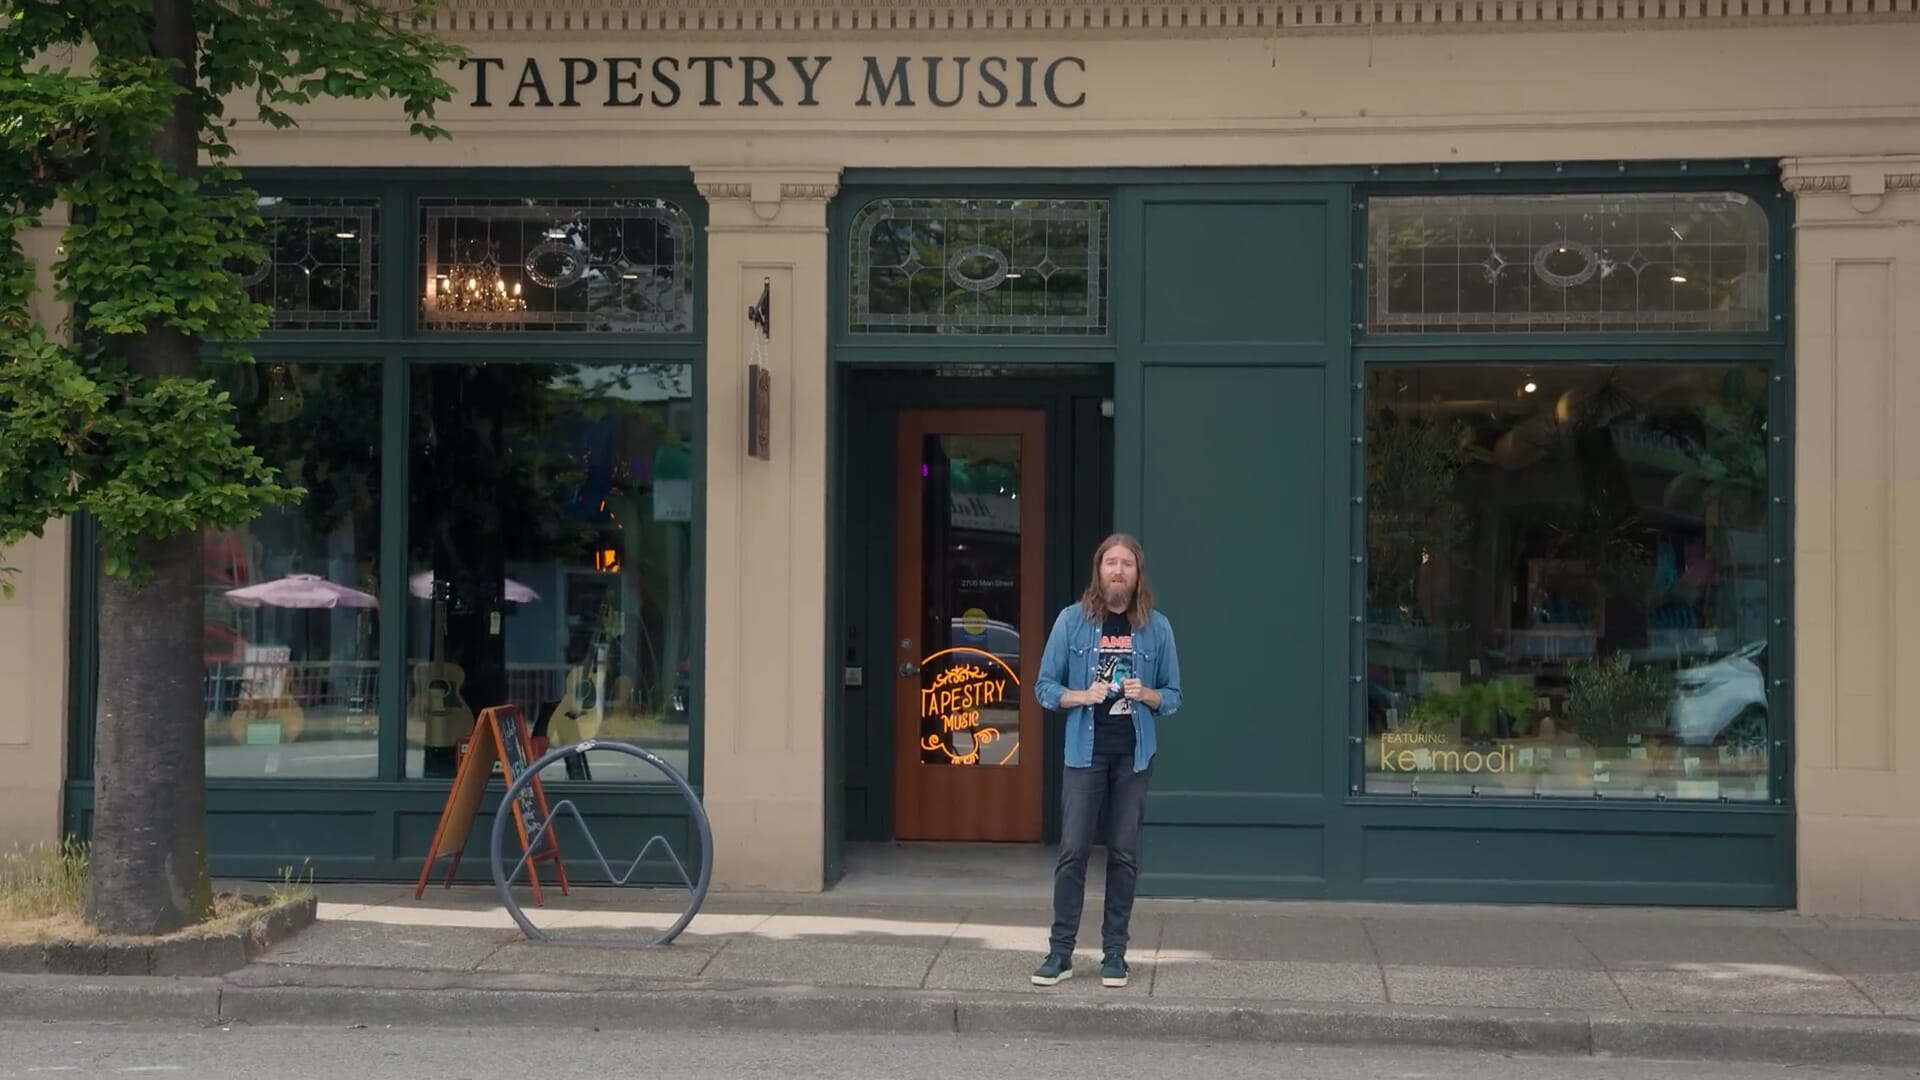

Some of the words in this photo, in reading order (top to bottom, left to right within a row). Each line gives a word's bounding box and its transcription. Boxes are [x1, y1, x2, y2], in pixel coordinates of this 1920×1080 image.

[460, 56, 832, 108] TAPESTRY
[856, 55, 1087, 108] MUSIC
[921, 679, 1006, 718] TAPESTRY
[940, 710, 980, 733] MUSIC
[1381, 733, 1449, 744] FEATURING:
[1381, 742, 1514, 773] kemodi
